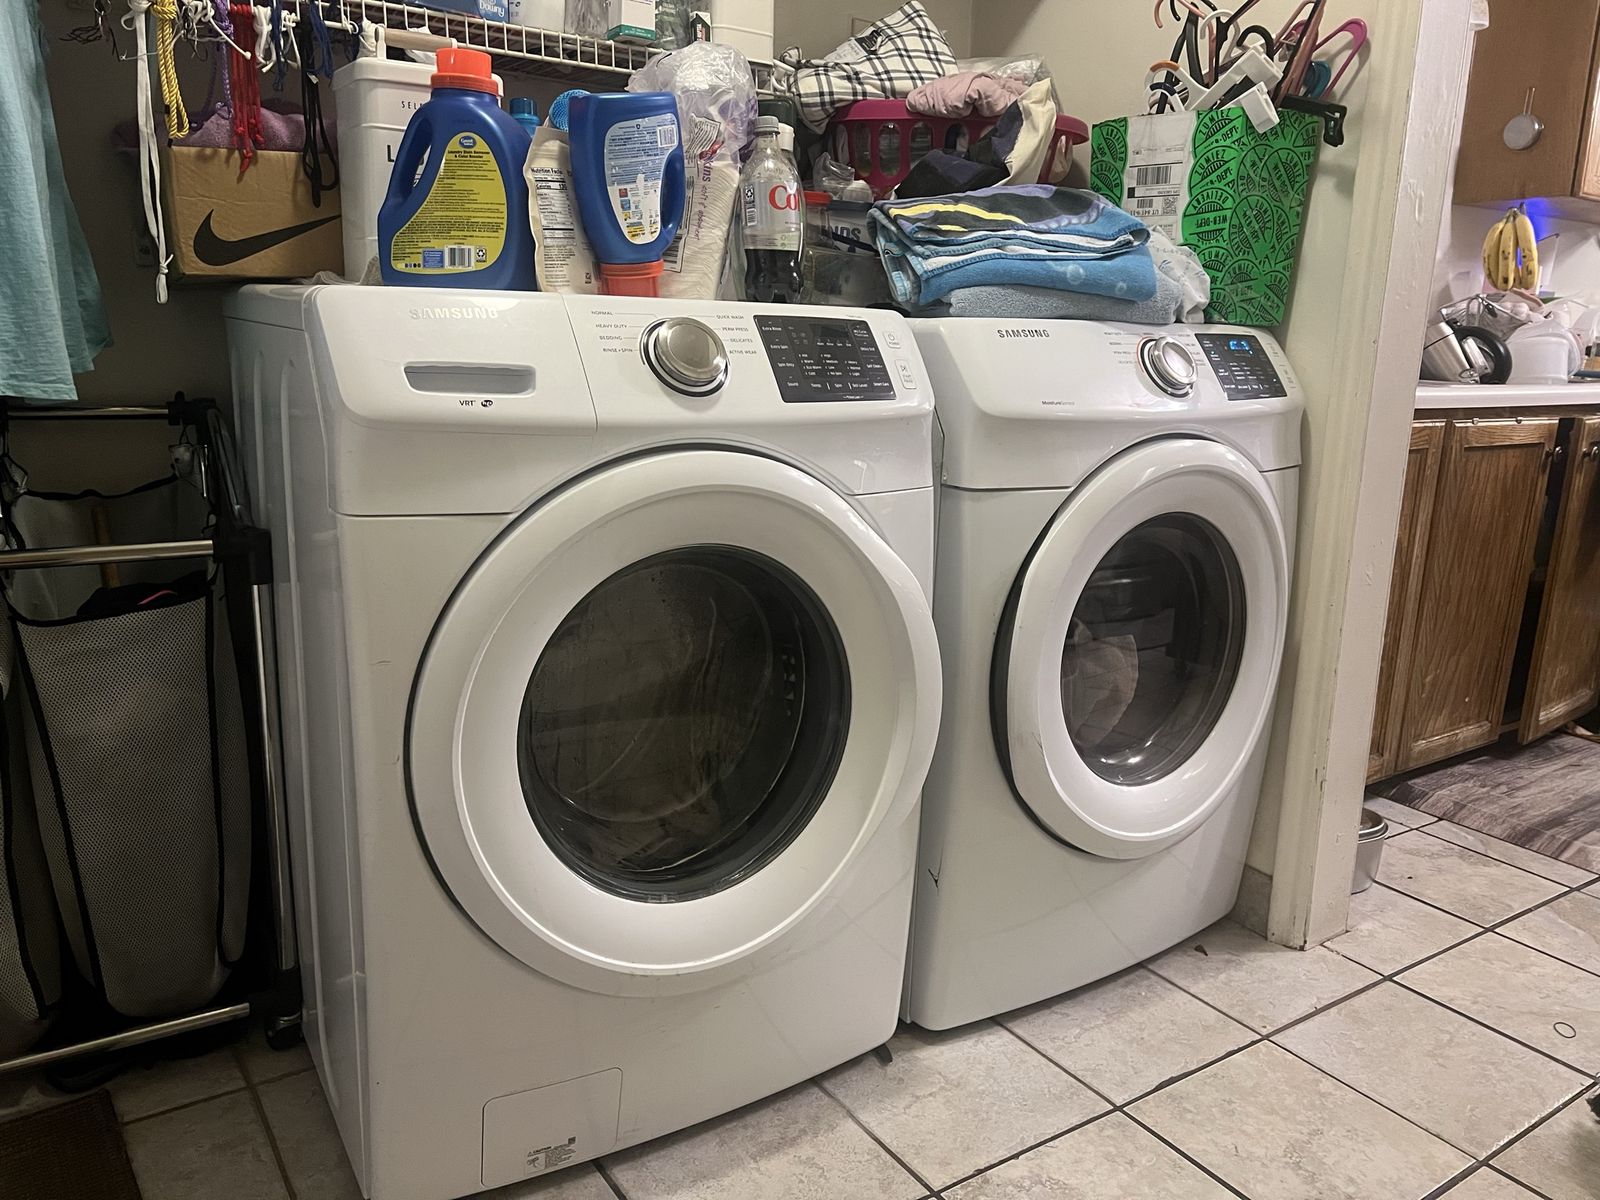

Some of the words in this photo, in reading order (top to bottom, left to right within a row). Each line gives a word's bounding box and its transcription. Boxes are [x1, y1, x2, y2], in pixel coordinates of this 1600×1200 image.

[480, 0, 505, 17] Downy
[1198, 108, 1232, 137] ZUMIEZ
[1194, 149, 1226, 177] ZUMIEZ
[1192, 190, 1230, 211] DELIVERY
[1255, 199, 1272, 231] ZUMIEZ
[409, 307, 499, 320] SAMSUNG
[997, 329, 1050, 338] SAMSUNG
